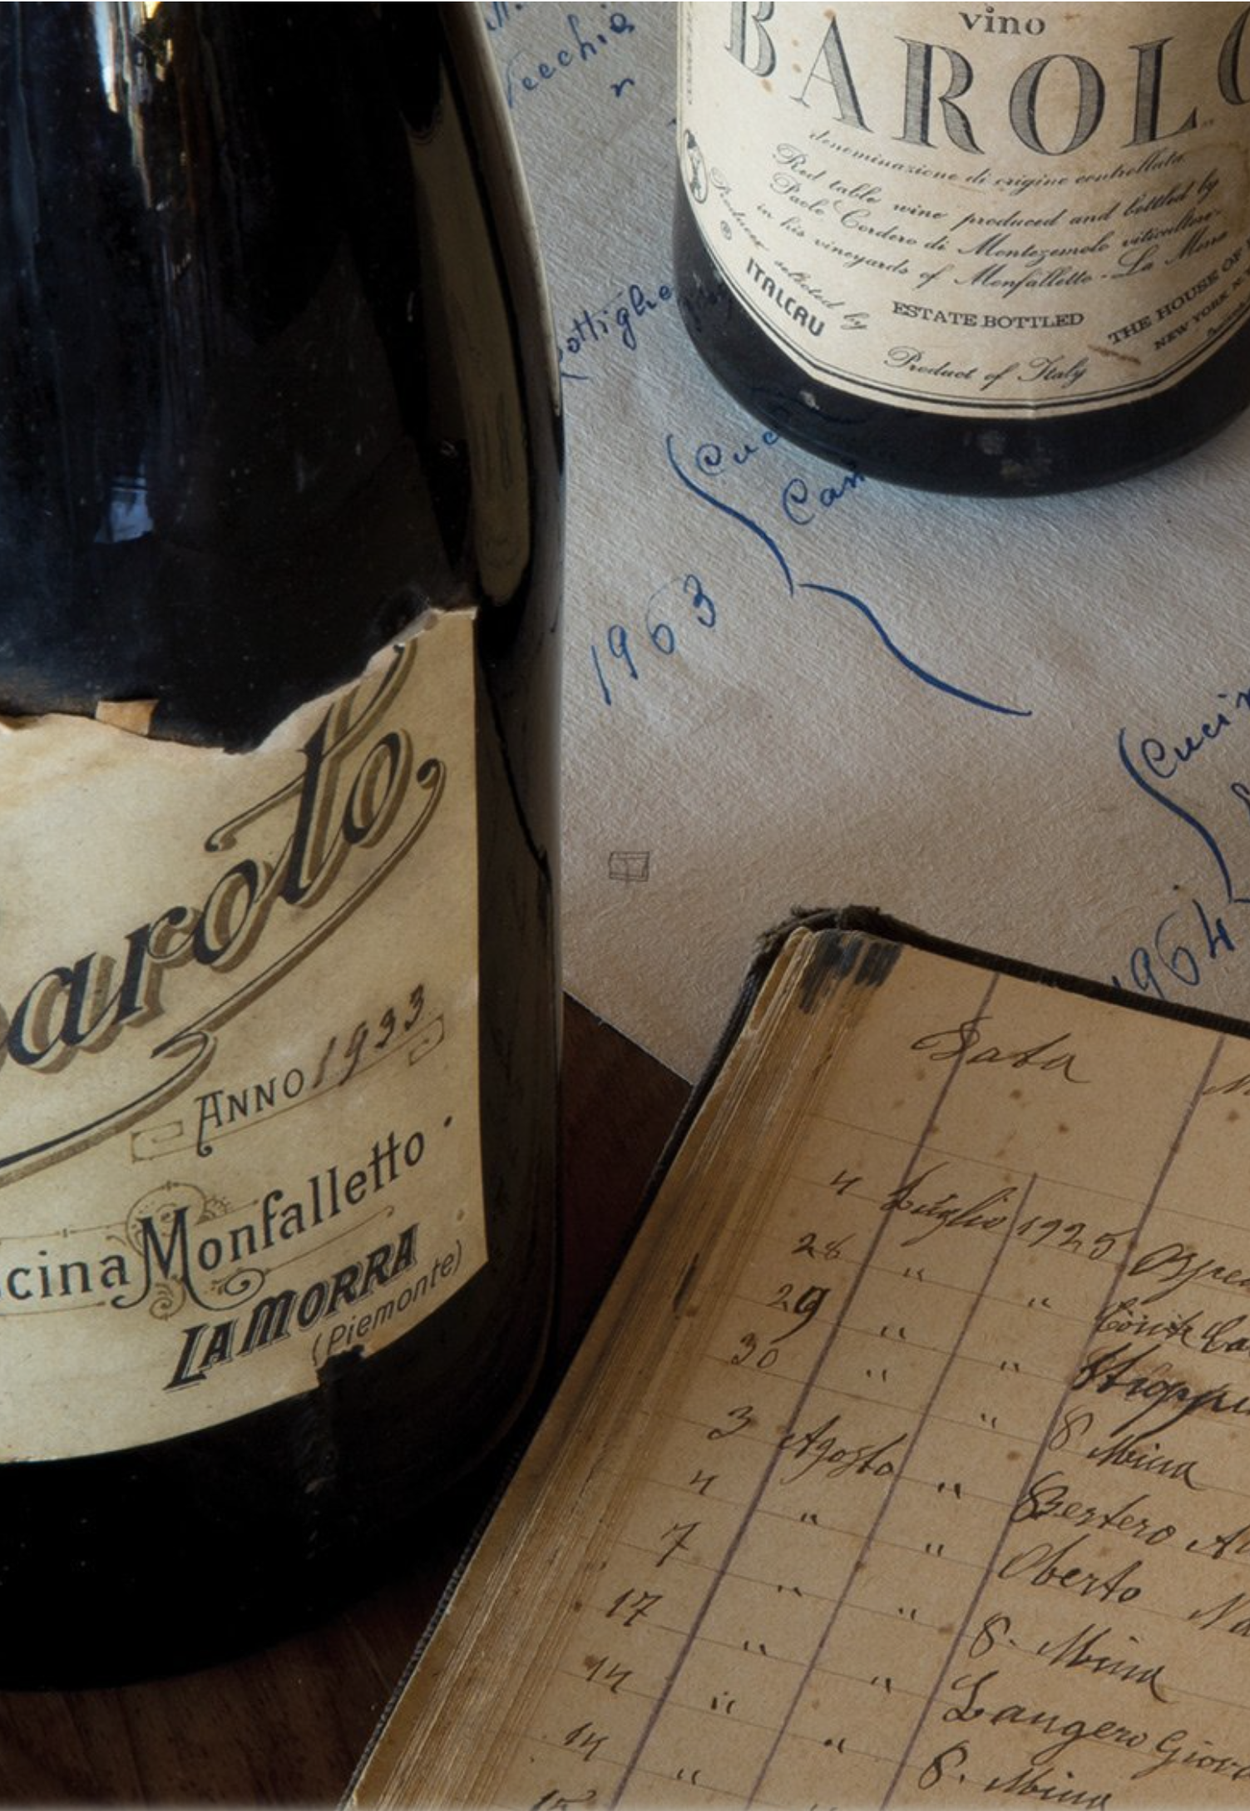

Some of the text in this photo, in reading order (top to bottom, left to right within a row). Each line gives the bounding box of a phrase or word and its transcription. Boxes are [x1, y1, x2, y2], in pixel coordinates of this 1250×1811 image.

[959, 5, 1046, 37] vino
[772, 143, 827, 182] Red
[829, 180, 882, 204] table
[893, 202, 948, 220] wine
[950, 209, 1068, 232] produced
[1069, 202, 1121, 225] and
[1123, 181, 1196, 217] bottled
[809, 130, 960, 181] denominazione
[965, 168, 991, 185] di
[994, 173, 1069, 196] origine
[756, 203, 775, 220] in
[780, 215, 805, 238] his
[814, 237, 910, 275] vineyards
[913, 264, 955, 291] of
[953, 264, 1093, 299] Monfalletto
[770, 171, 825, 216] Paolo
[833, 198, 918, 246] Cordero
[924, 235, 949, 251] di
[957, 231, 1115, 267] Montezemolo
[840, 311, 870, 332] by
[892, 301, 1085, 330] ESTATE BOTTLED
[1108, 315, 1152, 345] THE
[1155, 271, 1221, 320] HOUSE
[1221, 247, 1244, 273] OF
[1154, 320, 1190, 351] NEW
[1192, 291, 1231, 323] YORK
[884, 345, 1090, 392] Product of Italy
[591, 574, 717, 706] 1963
[0, 640, 420, 1072] arolo
[911, 1016, 1090, 1084] Data
[194, 1068, 304, 1157] ANNO
[0, 1131, 425, 1312] cina Monfalletto
[163, 1222, 420, 1392] LA MORRA
